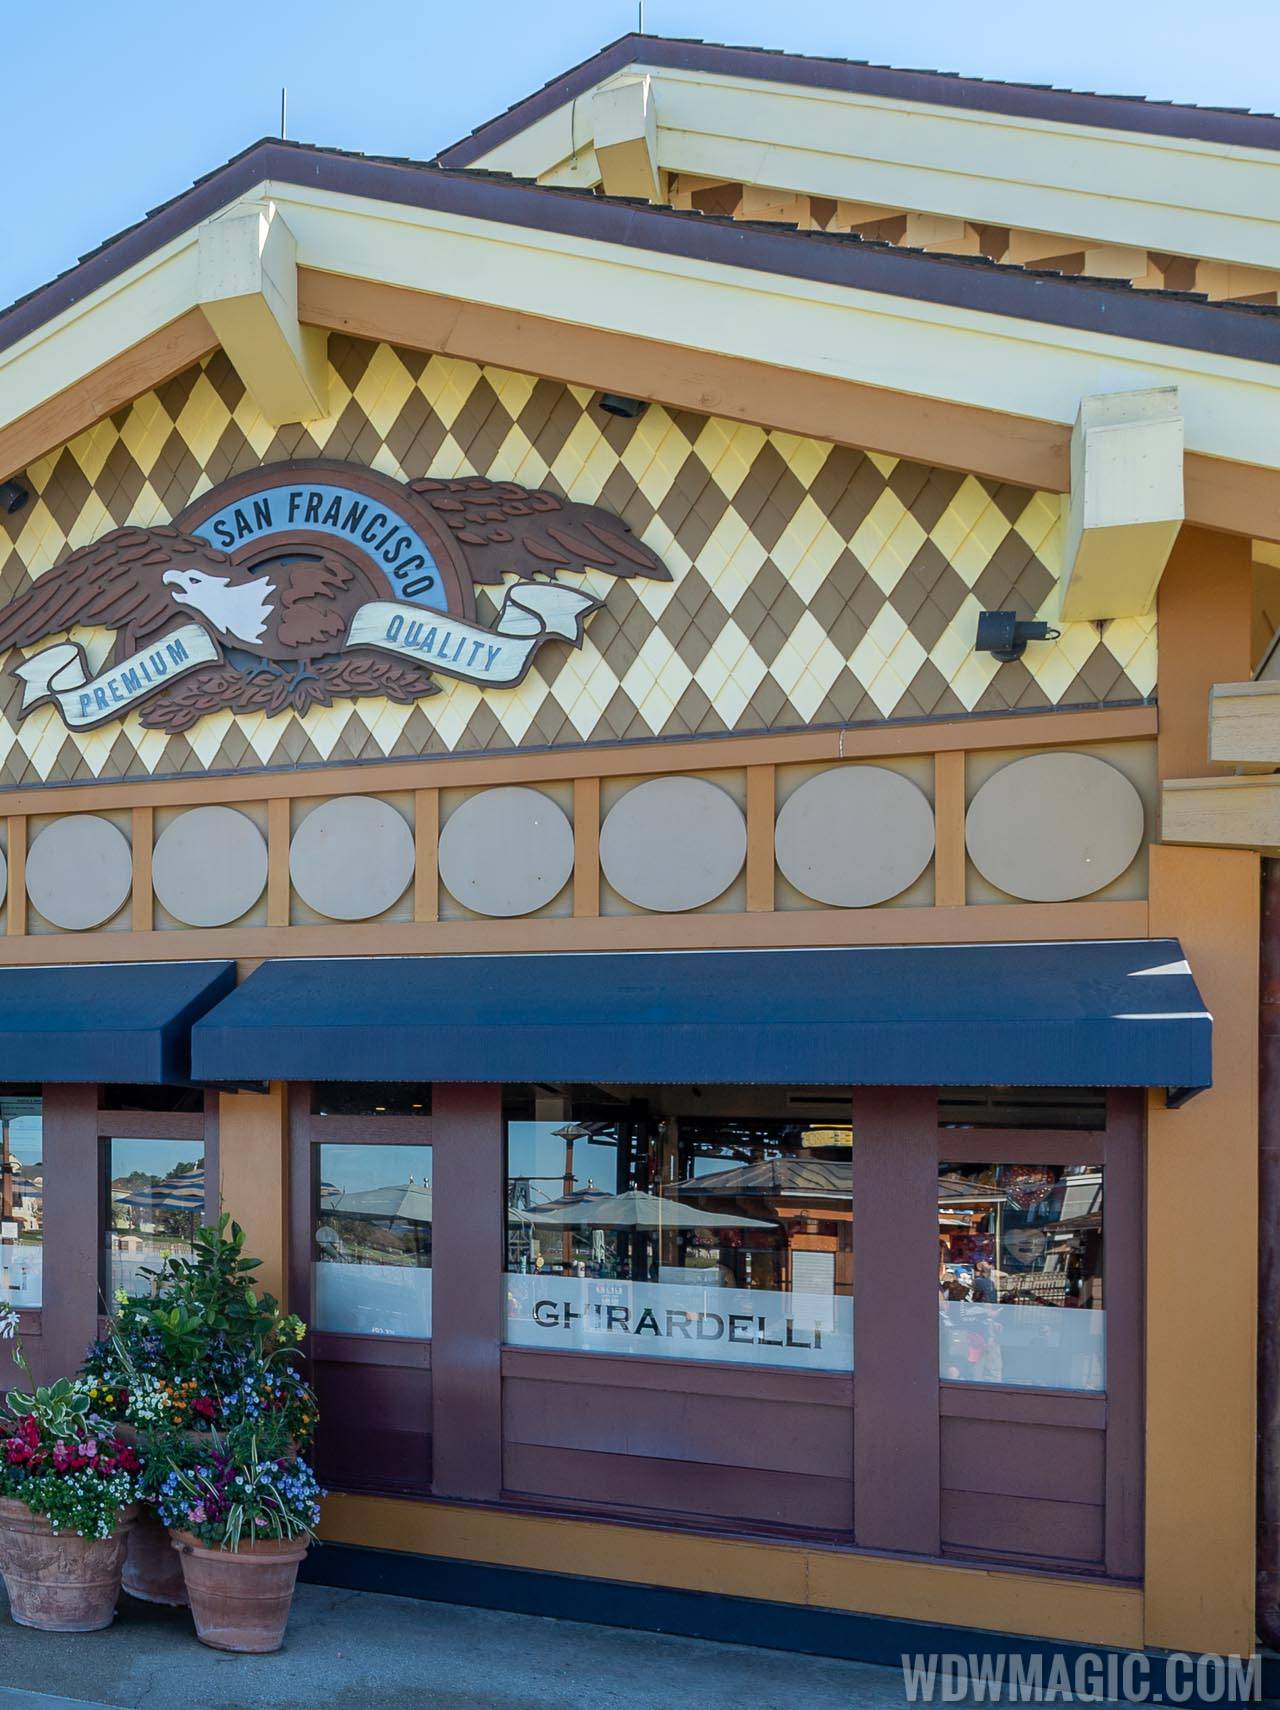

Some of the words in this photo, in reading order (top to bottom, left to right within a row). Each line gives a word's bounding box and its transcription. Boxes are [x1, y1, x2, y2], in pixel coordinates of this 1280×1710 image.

[213, 497, 273, 548] SAN
[287, 491, 435, 598] FRANCISCO
[386, 614, 502, 672] QUALITY
[79, 638, 189, 717] PREMIUM
[532, 1299, 823, 1350] GHIRARDELLI
